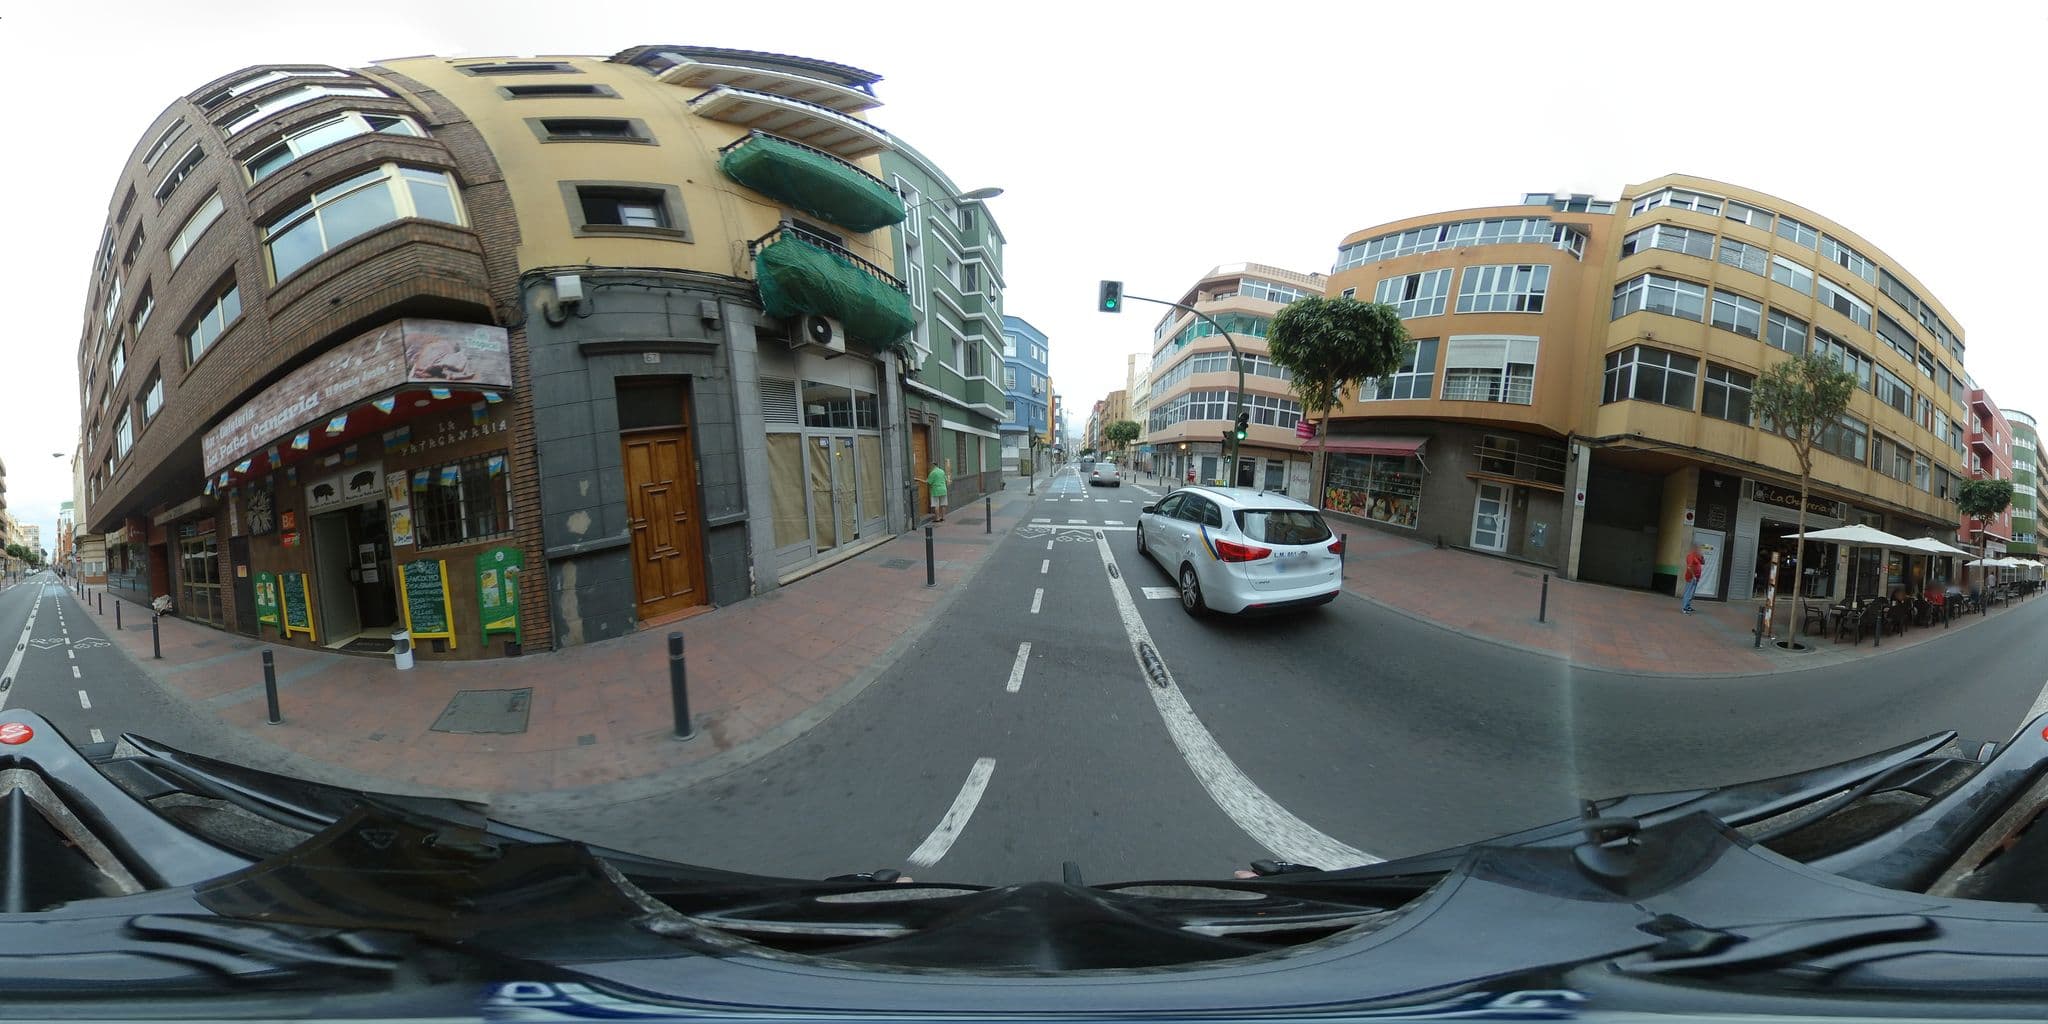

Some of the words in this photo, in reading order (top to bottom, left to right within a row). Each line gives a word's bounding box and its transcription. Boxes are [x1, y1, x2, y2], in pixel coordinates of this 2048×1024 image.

[220, 432, 249, 458] Pata
[251, 391, 320, 440] Canaria
[439, 421, 455, 432] LA
[1769, 490, 1785, 504] La
